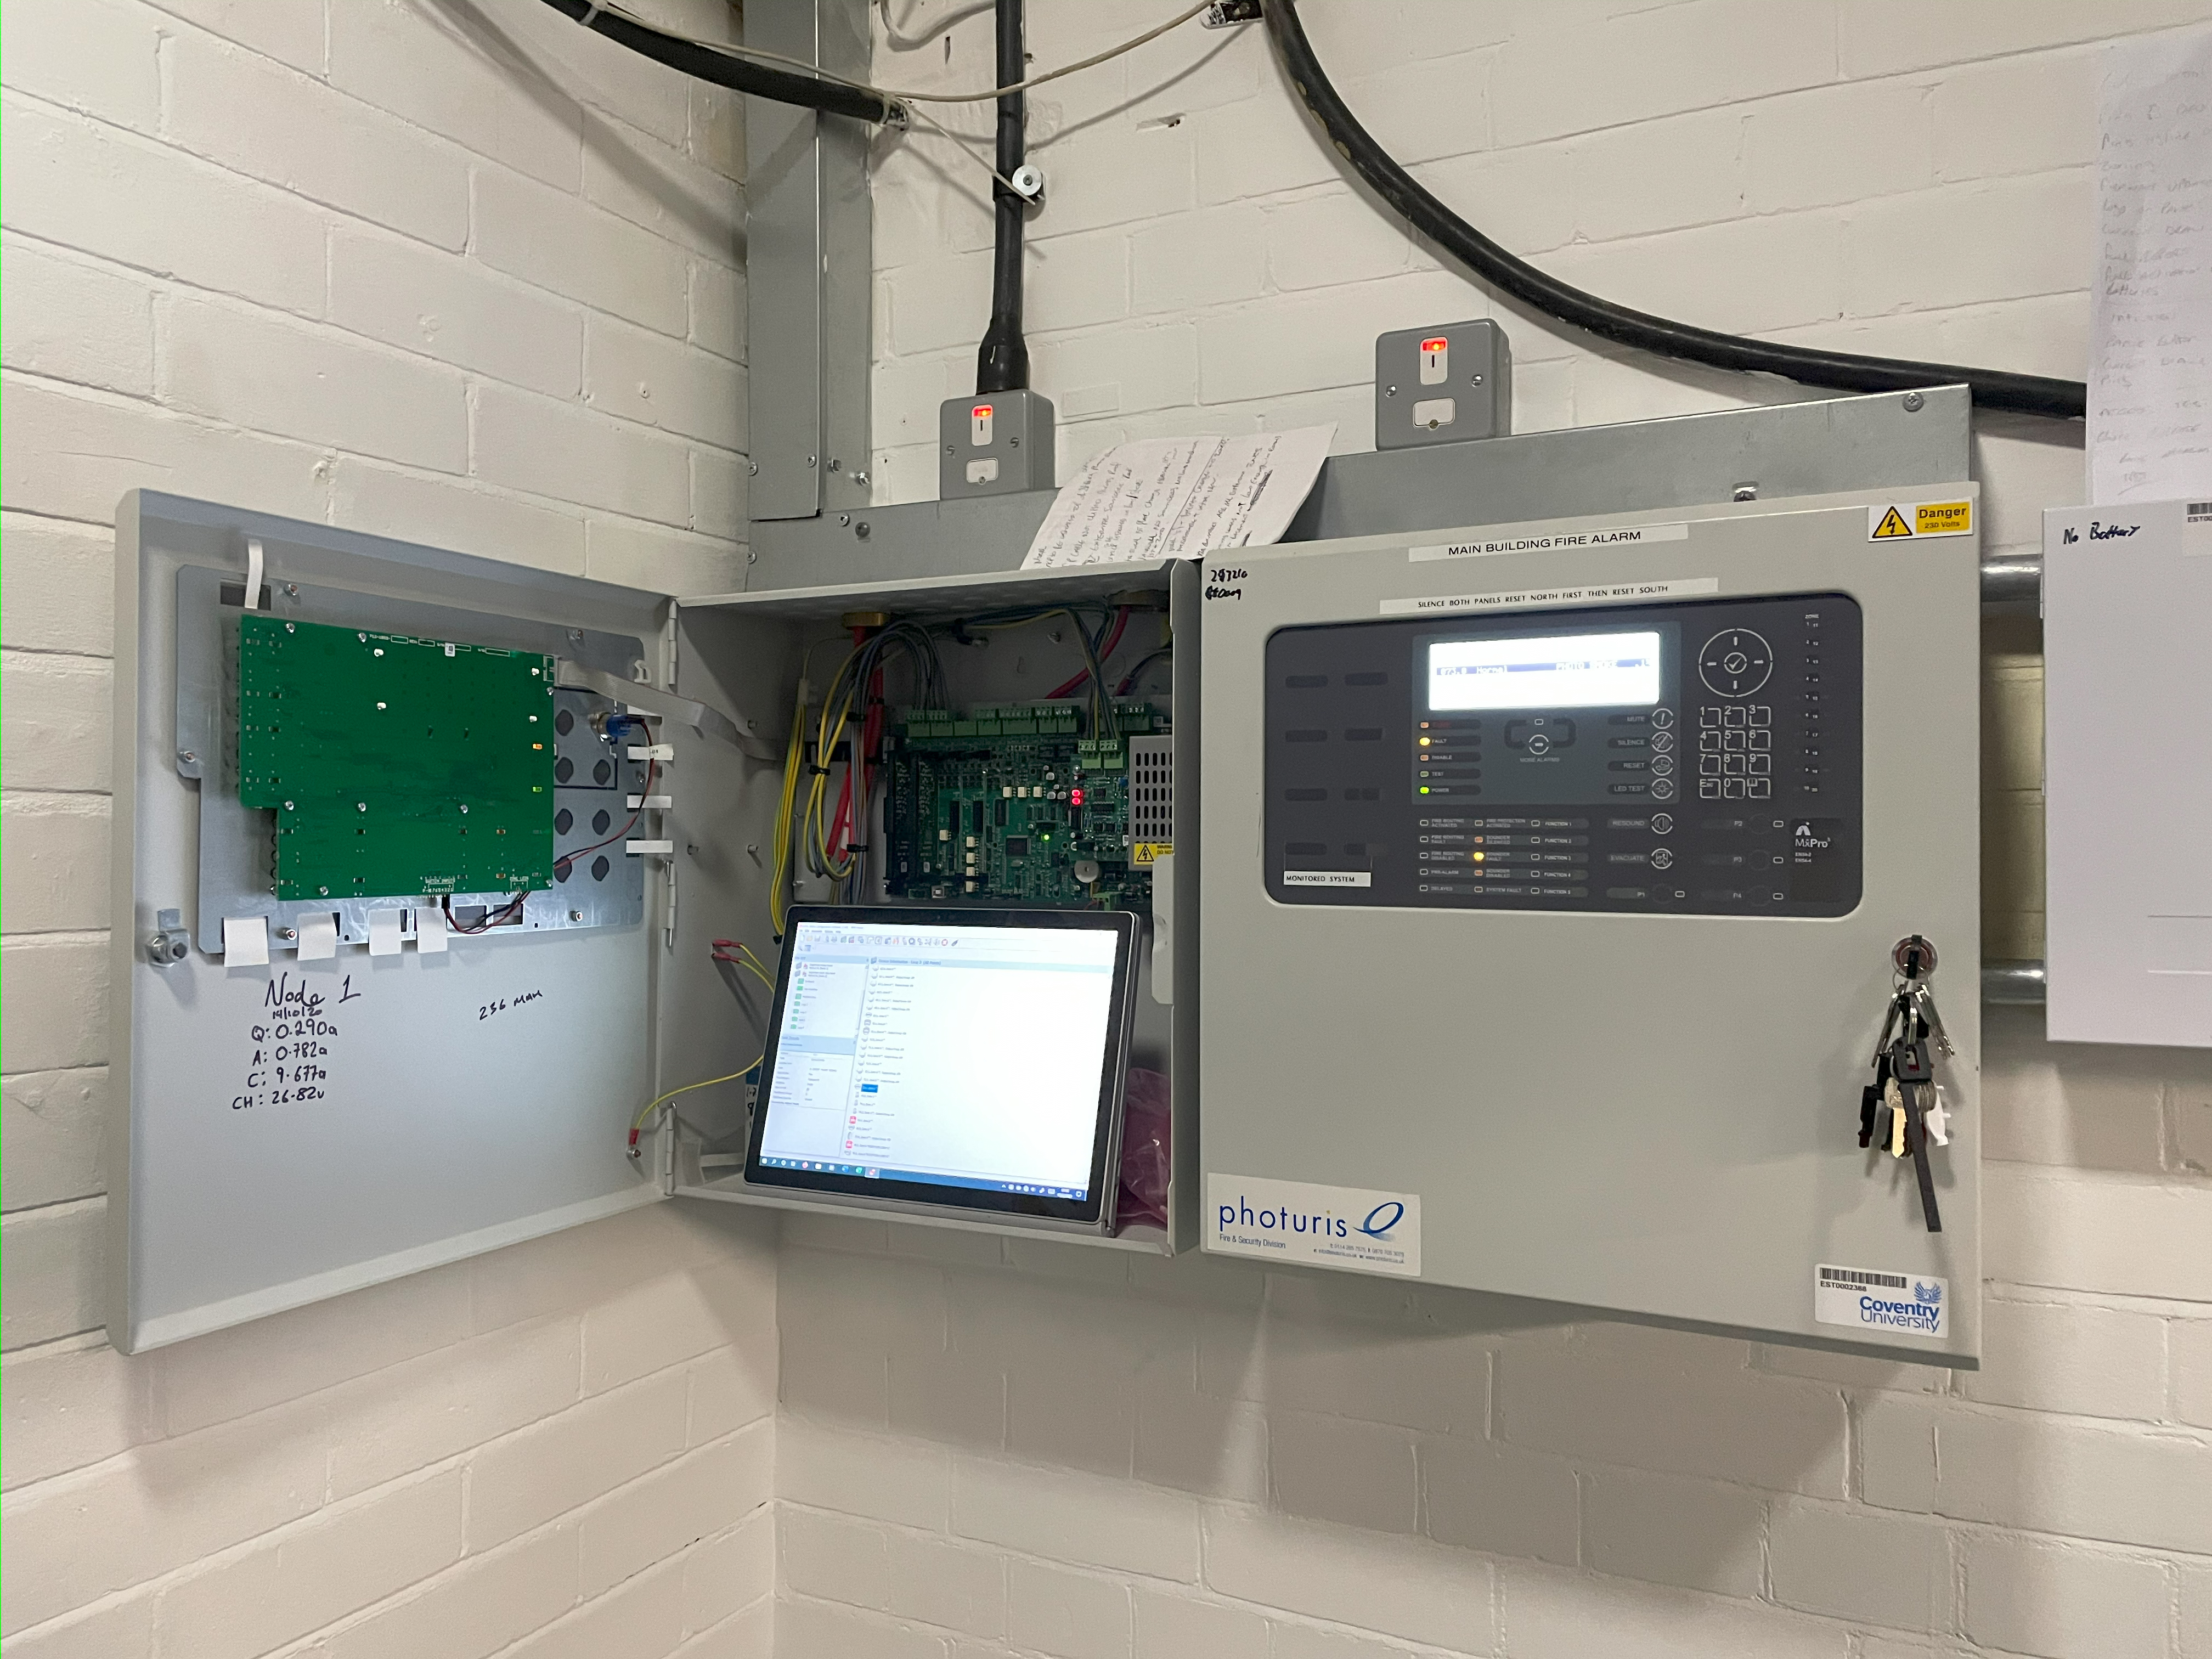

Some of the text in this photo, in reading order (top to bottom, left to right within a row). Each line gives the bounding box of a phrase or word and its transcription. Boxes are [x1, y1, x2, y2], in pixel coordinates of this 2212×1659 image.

[1919, 507, 1967, 518] Danger
[1449, 531, 1641, 555] MAIN BUILDING FIRE ALARM
[1700, 706, 1705, 715] 1
[1724, 706, 1732, 715] 2
[1749, 704, 1756, 714] 3
[1700, 731, 1707, 740] 4
[1724, 730, 1731, 740] 5
[1749, 730, 1756, 738] 6
[1700, 754, 1706, 763] 7
[1724, 754, 1731, 763] 8
[1750, 754, 1756, 763] 9
[1724, 778, 1731, 787] 0
[264, 972, 361, 1007] Node 1
[251, 1018, 337, 1043] Q: 0.290a
[252, 1041, 328, 1066] A: 0.782a
[247, 1065, 326, 1088] C: 9.677a
[1220, 1195, 1347, 1237] photuris
[1220, 1233, 1231, 1242] Fire
[1238, 1235, 1261, 1247] Security
[1263, 1239, 1286, 1249] Division
[1860, 1296, 1940, 1321] Coventry
[1861, 1309, 1940, 1333] University
